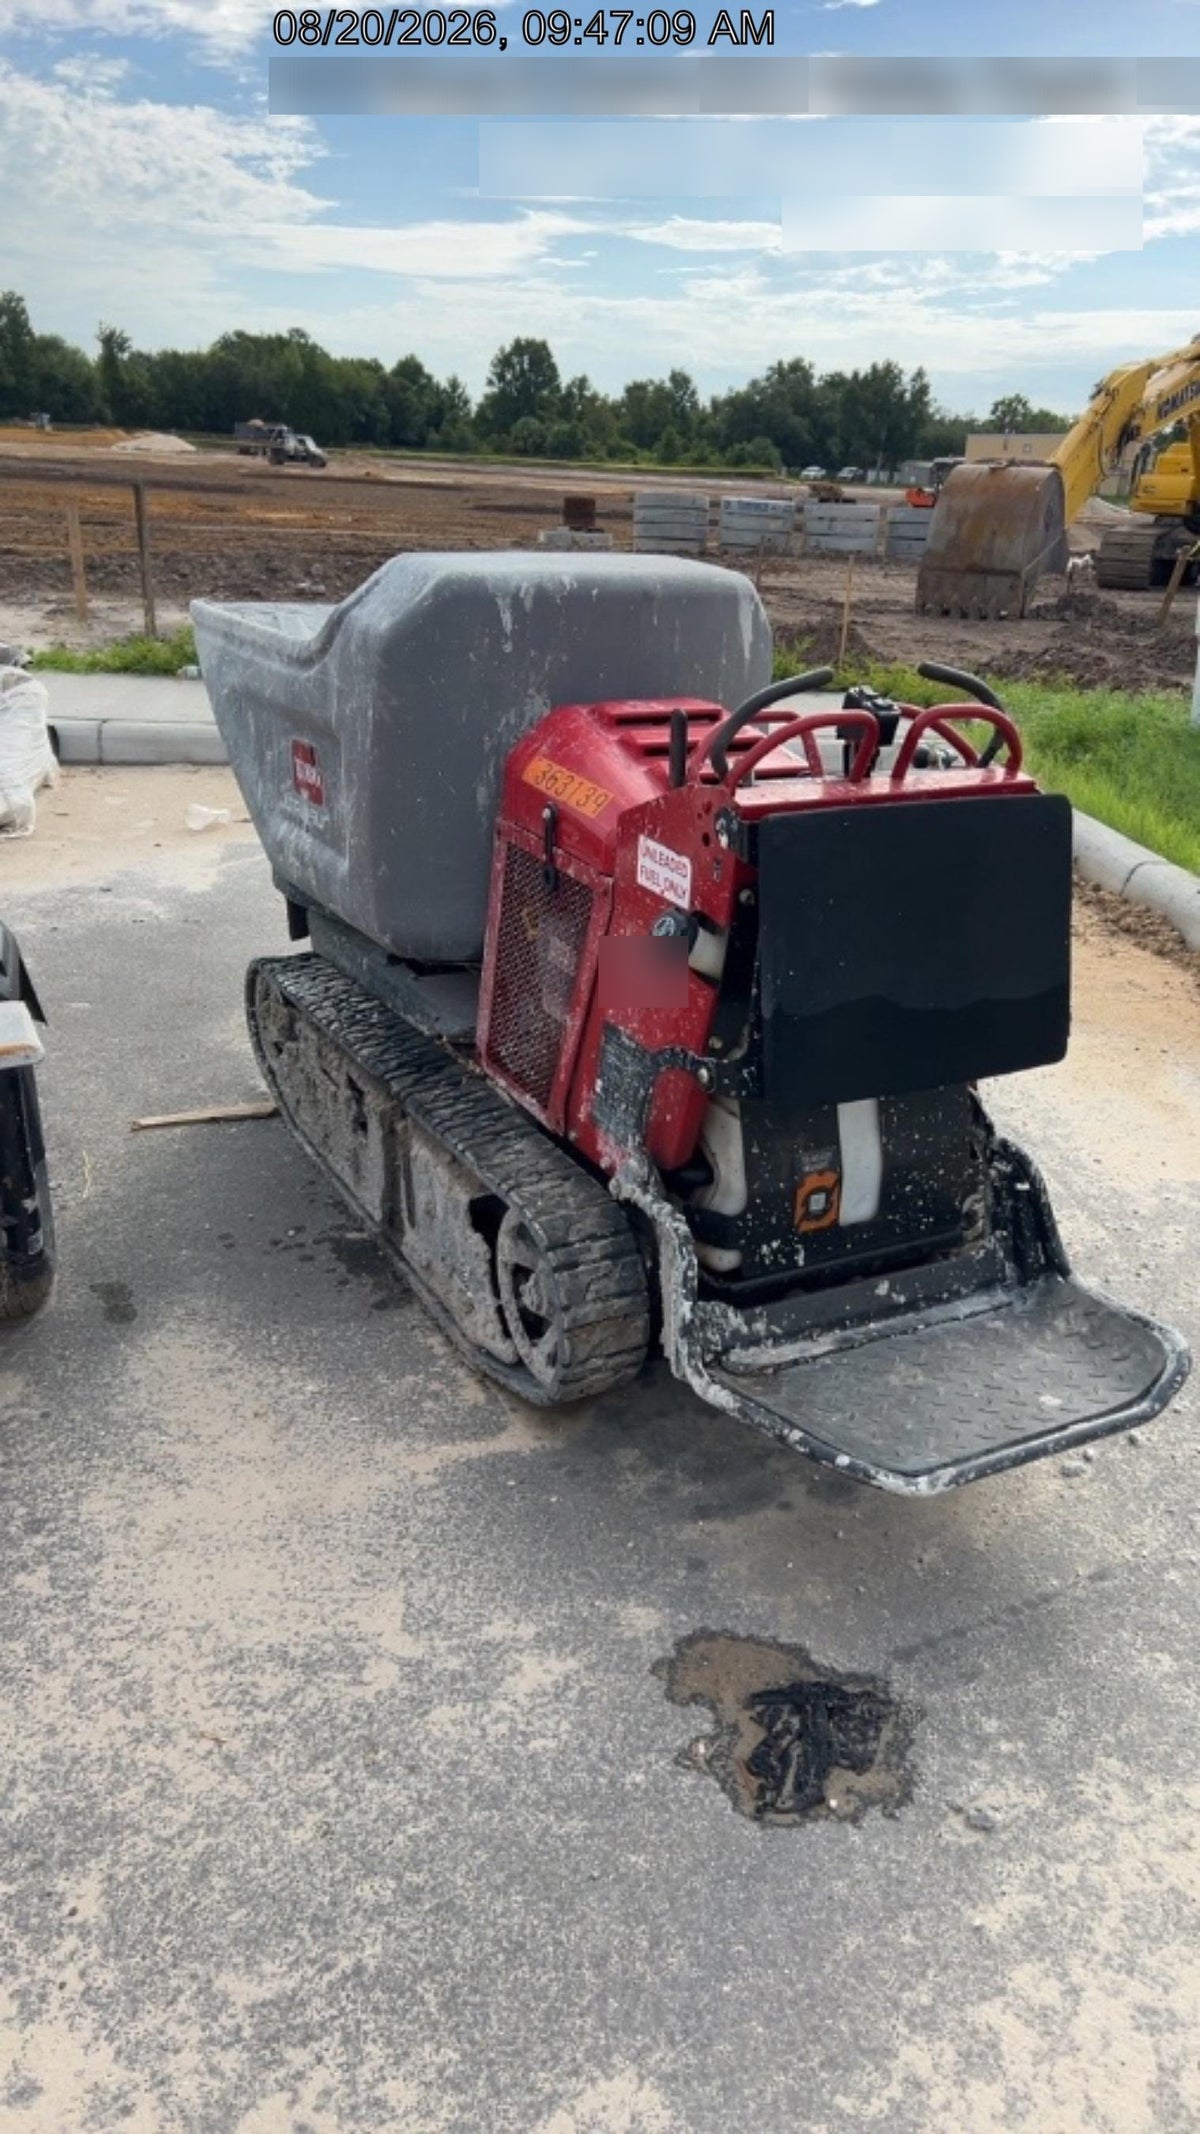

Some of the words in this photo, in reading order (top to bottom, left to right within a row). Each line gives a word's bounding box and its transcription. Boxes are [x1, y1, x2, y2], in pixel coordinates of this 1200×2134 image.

[534, 763, 609, 814] 363139
[640, 865, 661, 888] FUEL
[663, 876, 688, 900] ONLY
